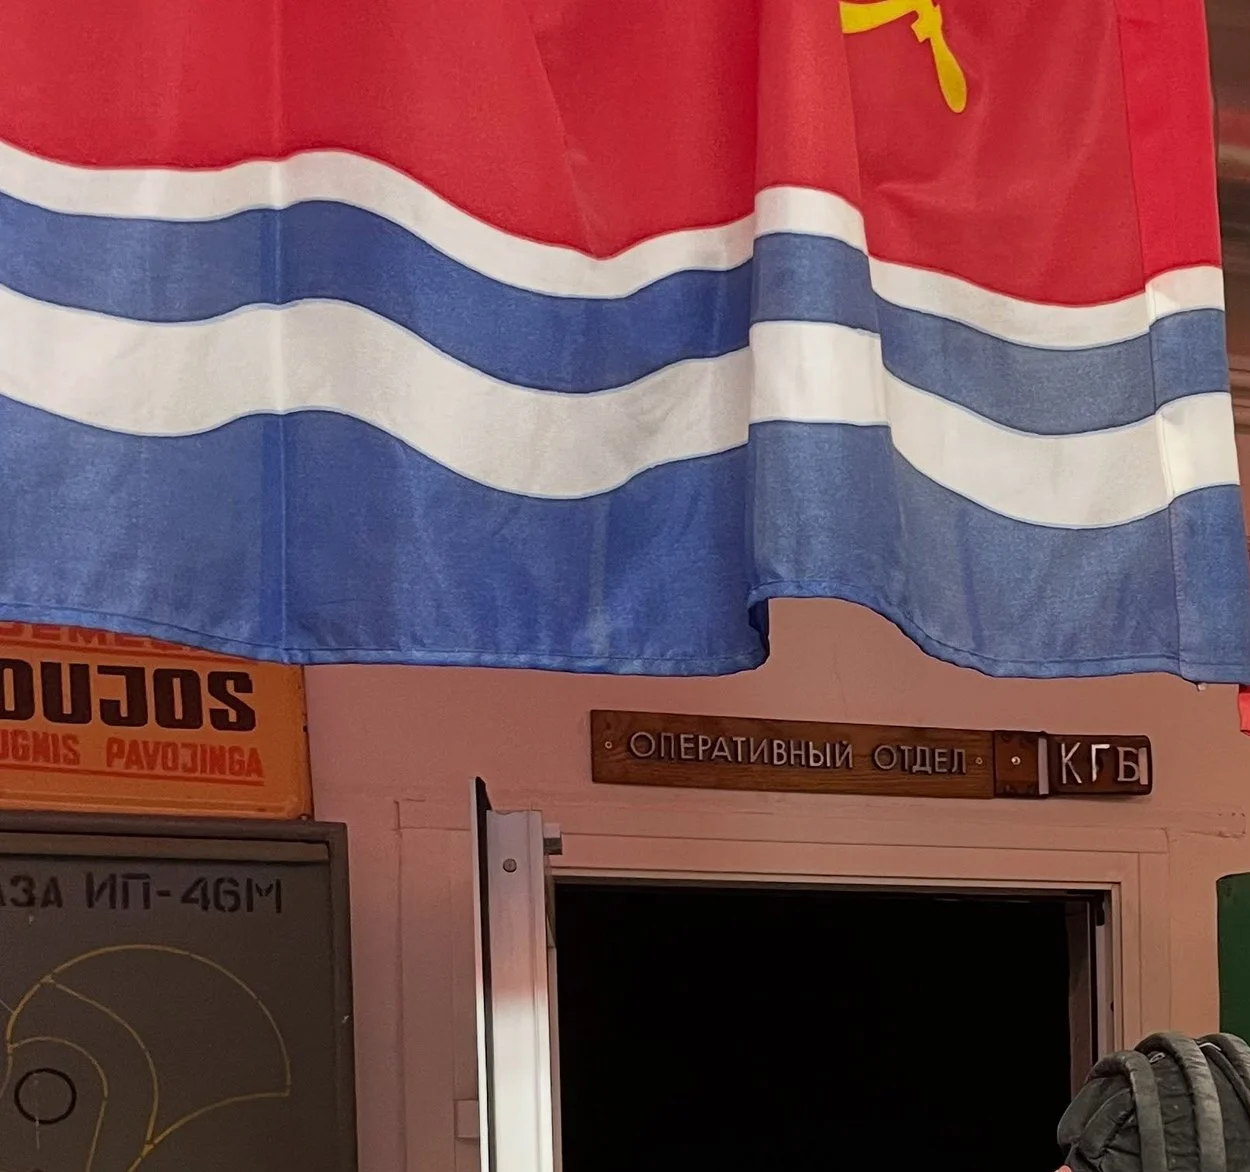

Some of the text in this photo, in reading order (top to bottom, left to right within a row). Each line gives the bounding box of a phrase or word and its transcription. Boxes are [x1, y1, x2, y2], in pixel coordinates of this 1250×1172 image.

[106, 737, 264, 777] PAVOJINGA
[629, 730, 1139, 784] ОПЕРАТИВНЫЙ ОТДЕЛ КГБ
[0, 871, 283, 913] ЗА ИП-46М
